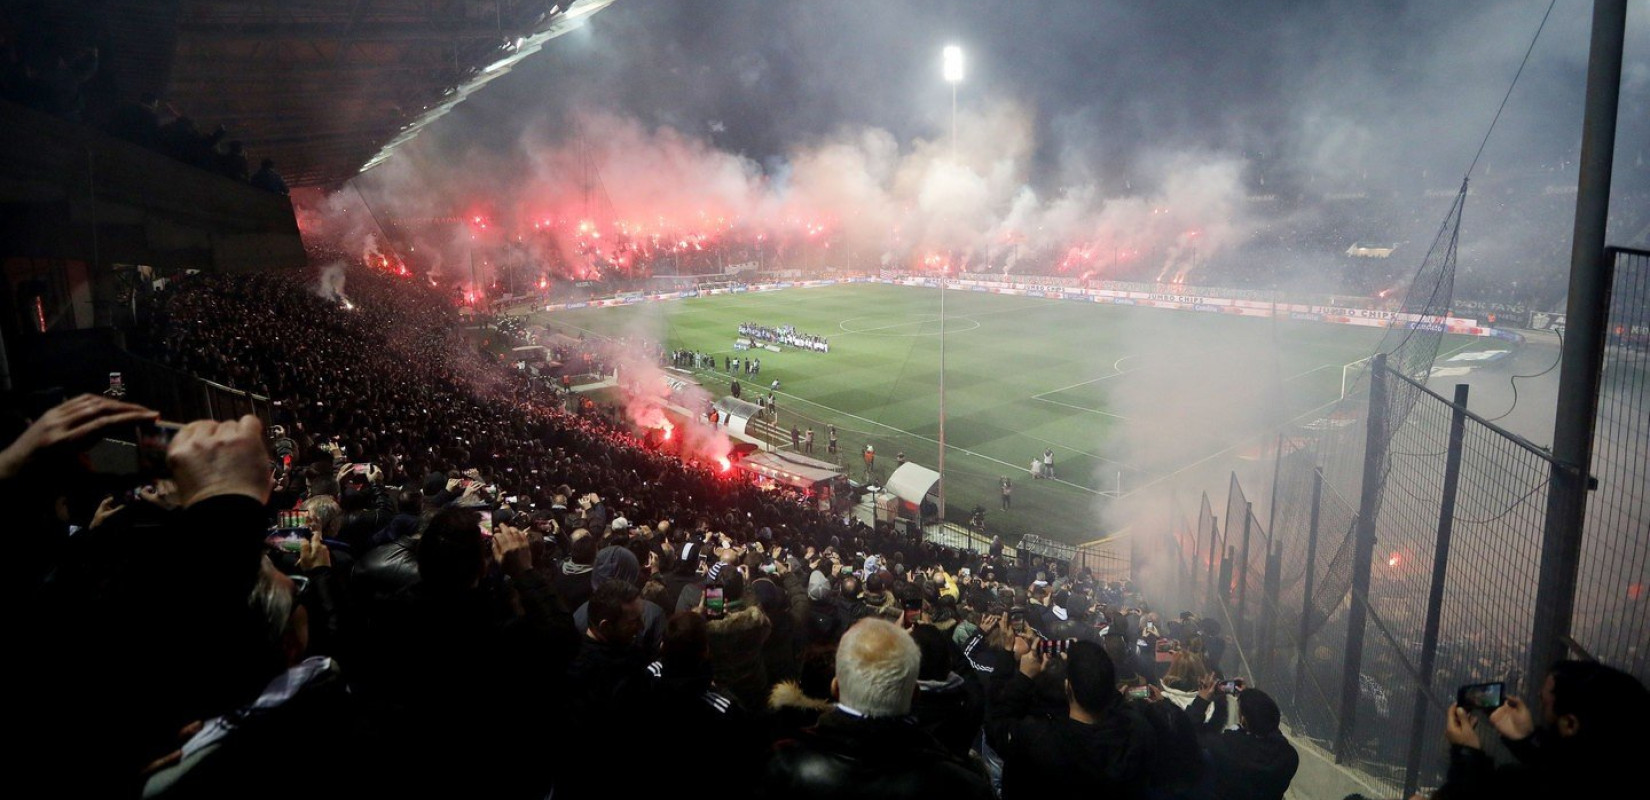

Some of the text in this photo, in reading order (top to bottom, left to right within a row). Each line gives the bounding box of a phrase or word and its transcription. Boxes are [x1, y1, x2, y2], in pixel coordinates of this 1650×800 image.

[1148, 293, 1203, 304] JUMBO CHIPS
[1319, 305, 1396, 320] JUMBO CHIPS
